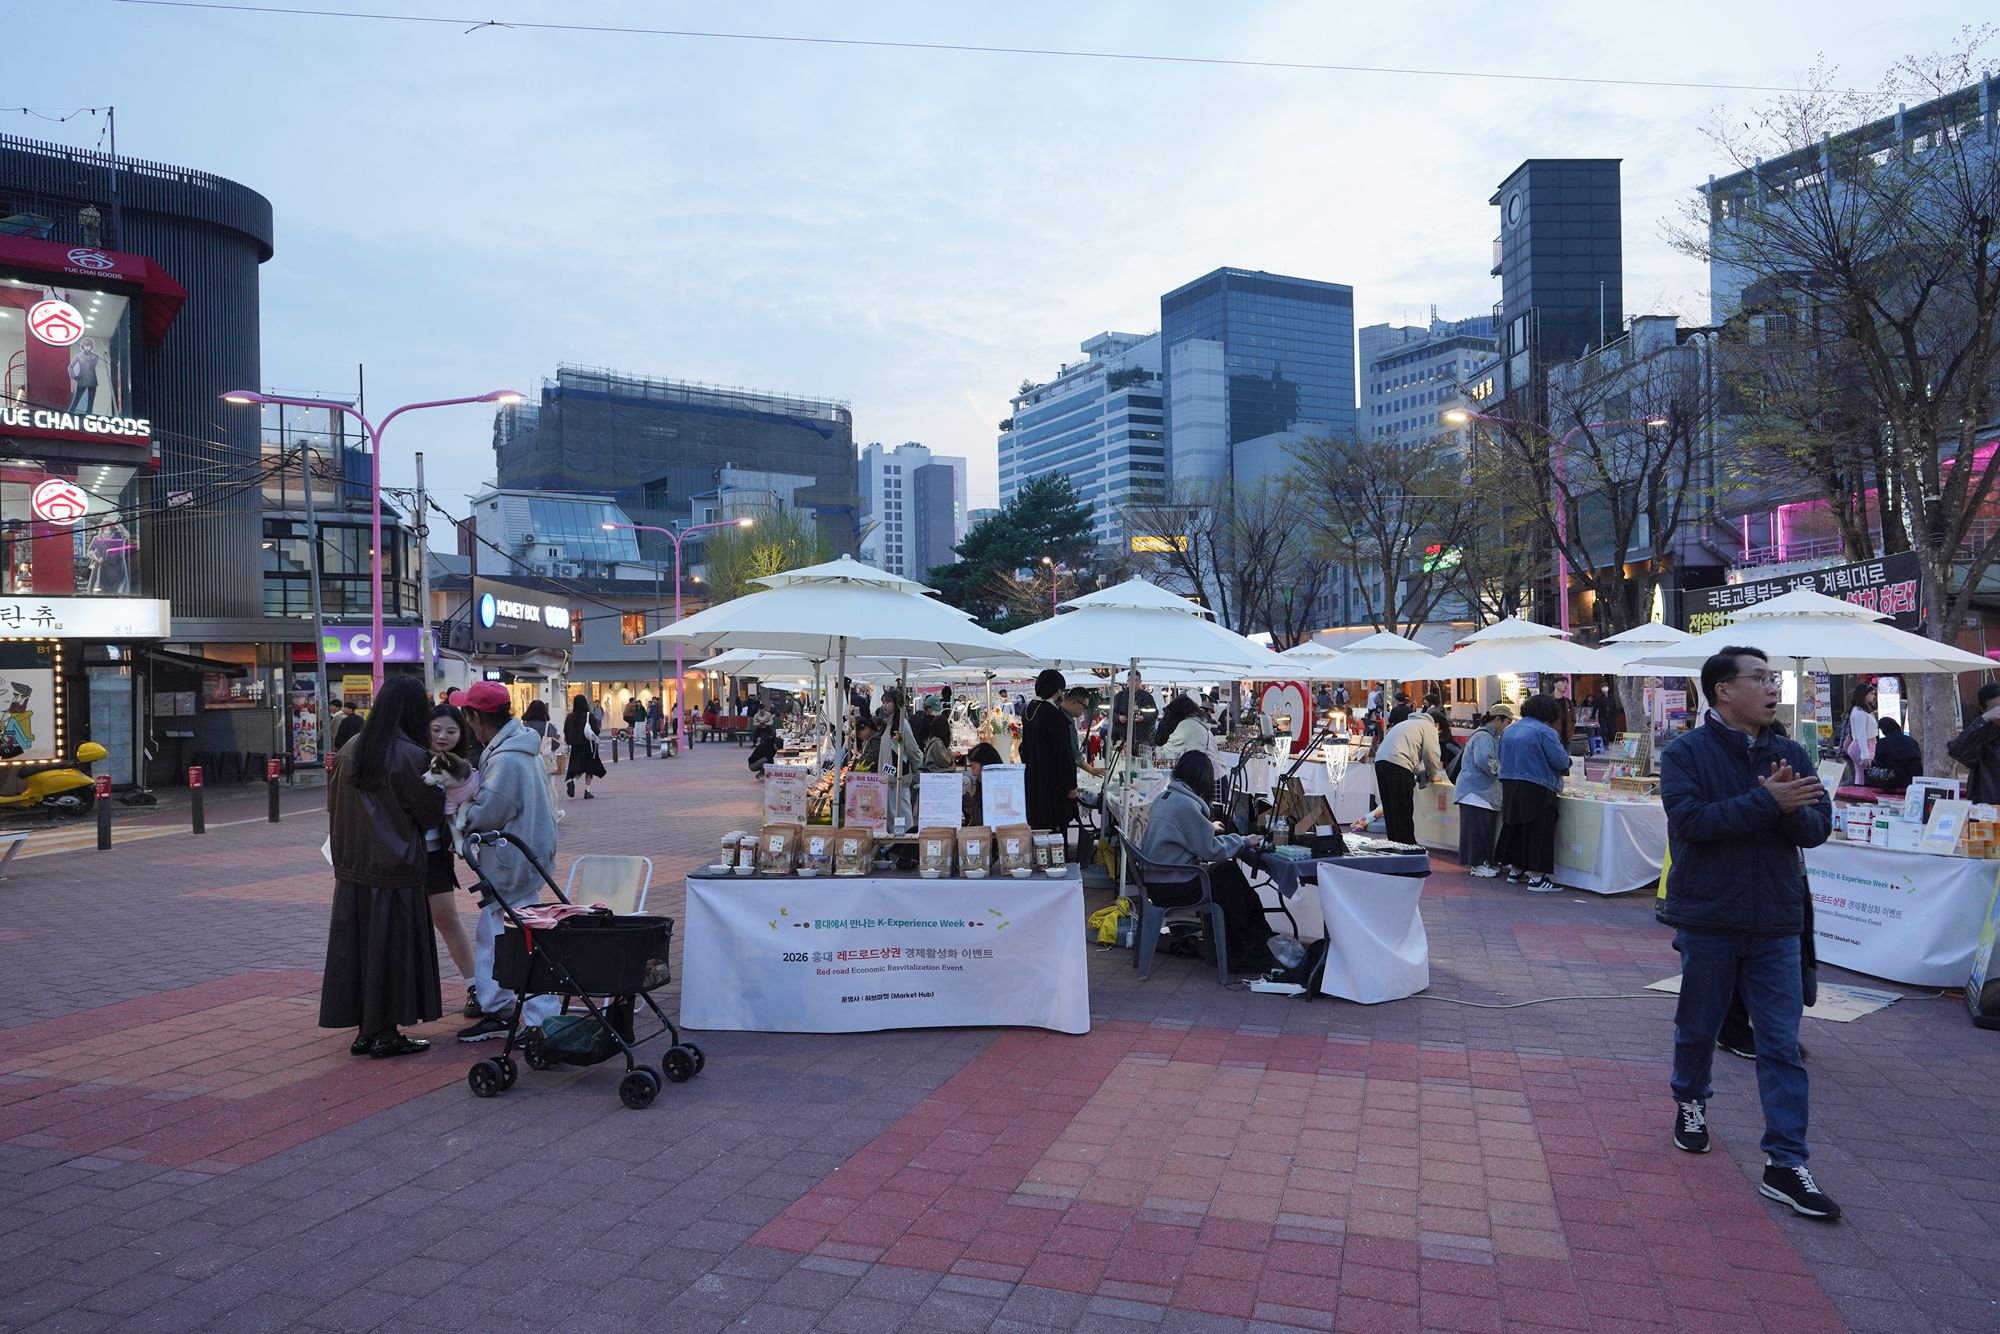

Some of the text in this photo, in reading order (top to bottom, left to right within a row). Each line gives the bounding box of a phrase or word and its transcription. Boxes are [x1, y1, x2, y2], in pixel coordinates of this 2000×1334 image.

[63, 266, 123, 280] YUE CHAI GOODS
[34, 410, 80, 430] CHAI
[83, 414, 151, 437] GOODS
[1708, 583, 1784, 609] 국토교통부는
[1820, 562, 1887, 592] 계획대로
[1880, 579, 1917, 615] 하라!
[496, 599, 525, 619] MONEY
[525, 604, 541, 622] BOX
[1836, 873, 1872, 886] K-Experience
[1872, 879, 1889, 889] Week
[1847, 899, 1881, 915] 경제활성화
[1882, 907, 1902, 920] 이벤트
[814, 918, 965, 929] 홍대에서 만나는 K-Experience Week
[782, 947, 994, 962] 2026 홍대 레드로드상권 경제활성화 이벤트
[816, 968, 831, 976] Red
[832, 967, 850, 975] road
[851, 965, 885, 974] Economic
